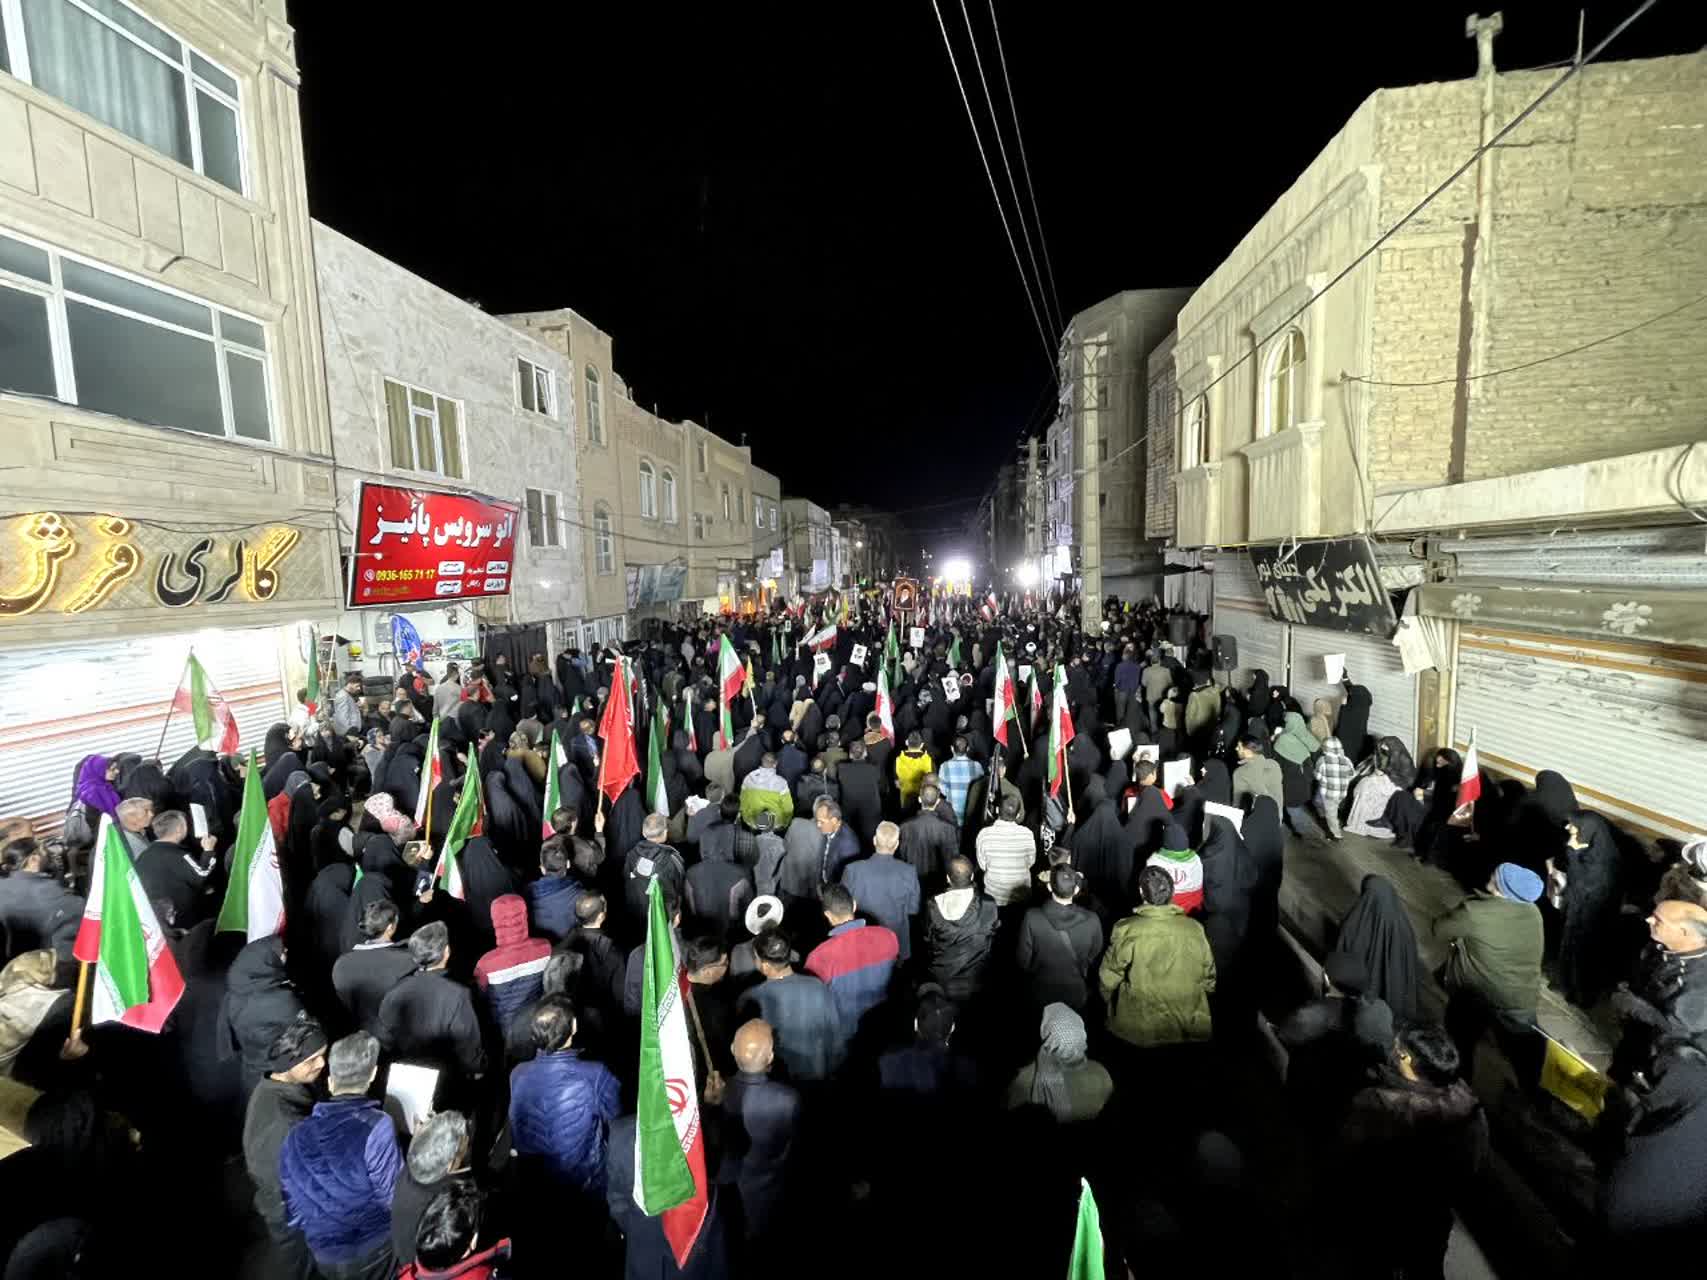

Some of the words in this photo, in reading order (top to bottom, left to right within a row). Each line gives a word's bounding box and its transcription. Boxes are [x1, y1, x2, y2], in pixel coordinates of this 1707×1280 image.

[370, 498, 431, 547] پائیز
[434, 516, 492, 548] سرویس
[0, 512, 139, 616] فرش
[154, 527, 300, 608] گالری
[1257, 558, 1272, 582] نور
[1298, 562, 1383, 617] الکتریکی
